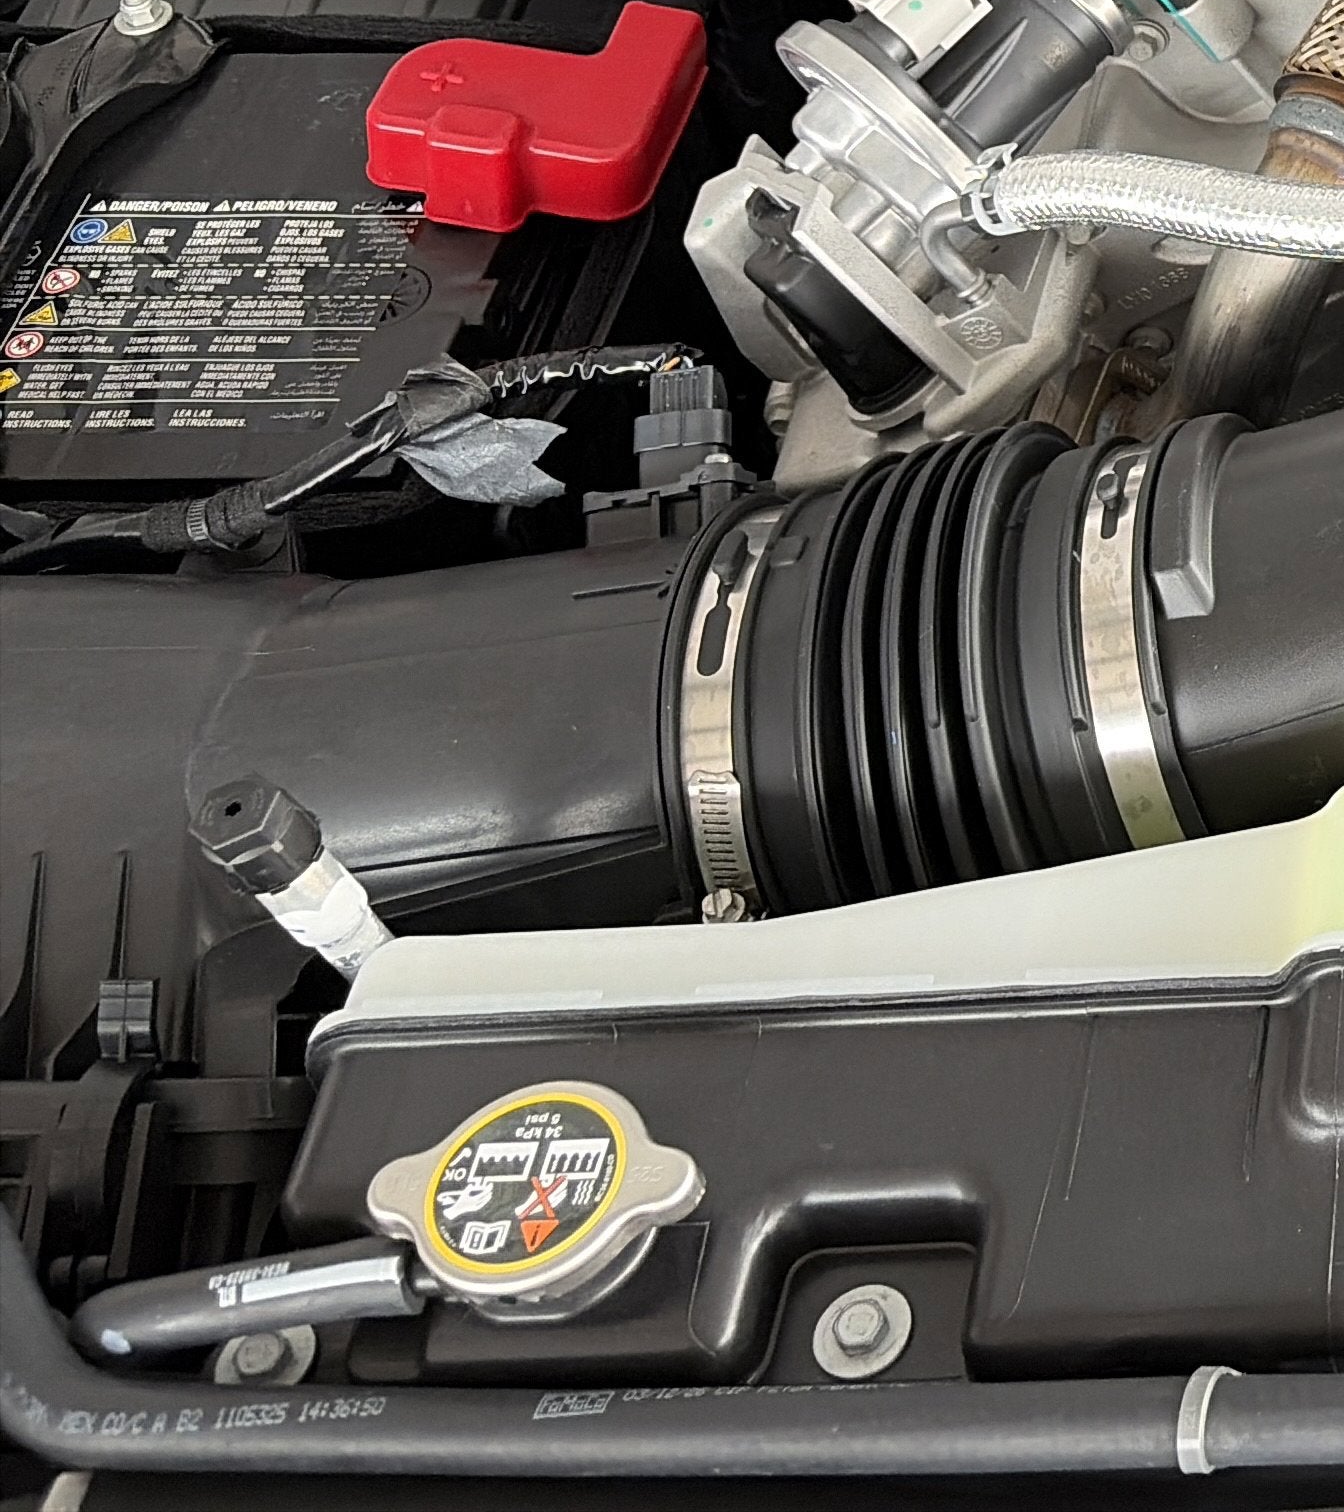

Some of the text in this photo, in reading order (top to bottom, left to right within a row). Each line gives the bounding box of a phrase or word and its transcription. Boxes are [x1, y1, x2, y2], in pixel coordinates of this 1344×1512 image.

[109, 201, 210, 212] DANGER/POISON
[232, 201, 338, 212] PELIGRO/VENENO
[7, 410, 34, 418] READ
[90, 410, 130, 418] LIRE LES
[172, 410, 214, 418] LEA LAS
[168, 418, 247, 428] INSTRUCCIONES.
[526, 1112, 550, 1125] psi
[515, 1126, 542, 1139] kPa
[444, 1167, 467, 1182] OK
[538, 1392, 612, 1418] FoMoCo
[175, 1408, 204, 1433] B2
[298, 1396, 387, 1423] 14:36:50
